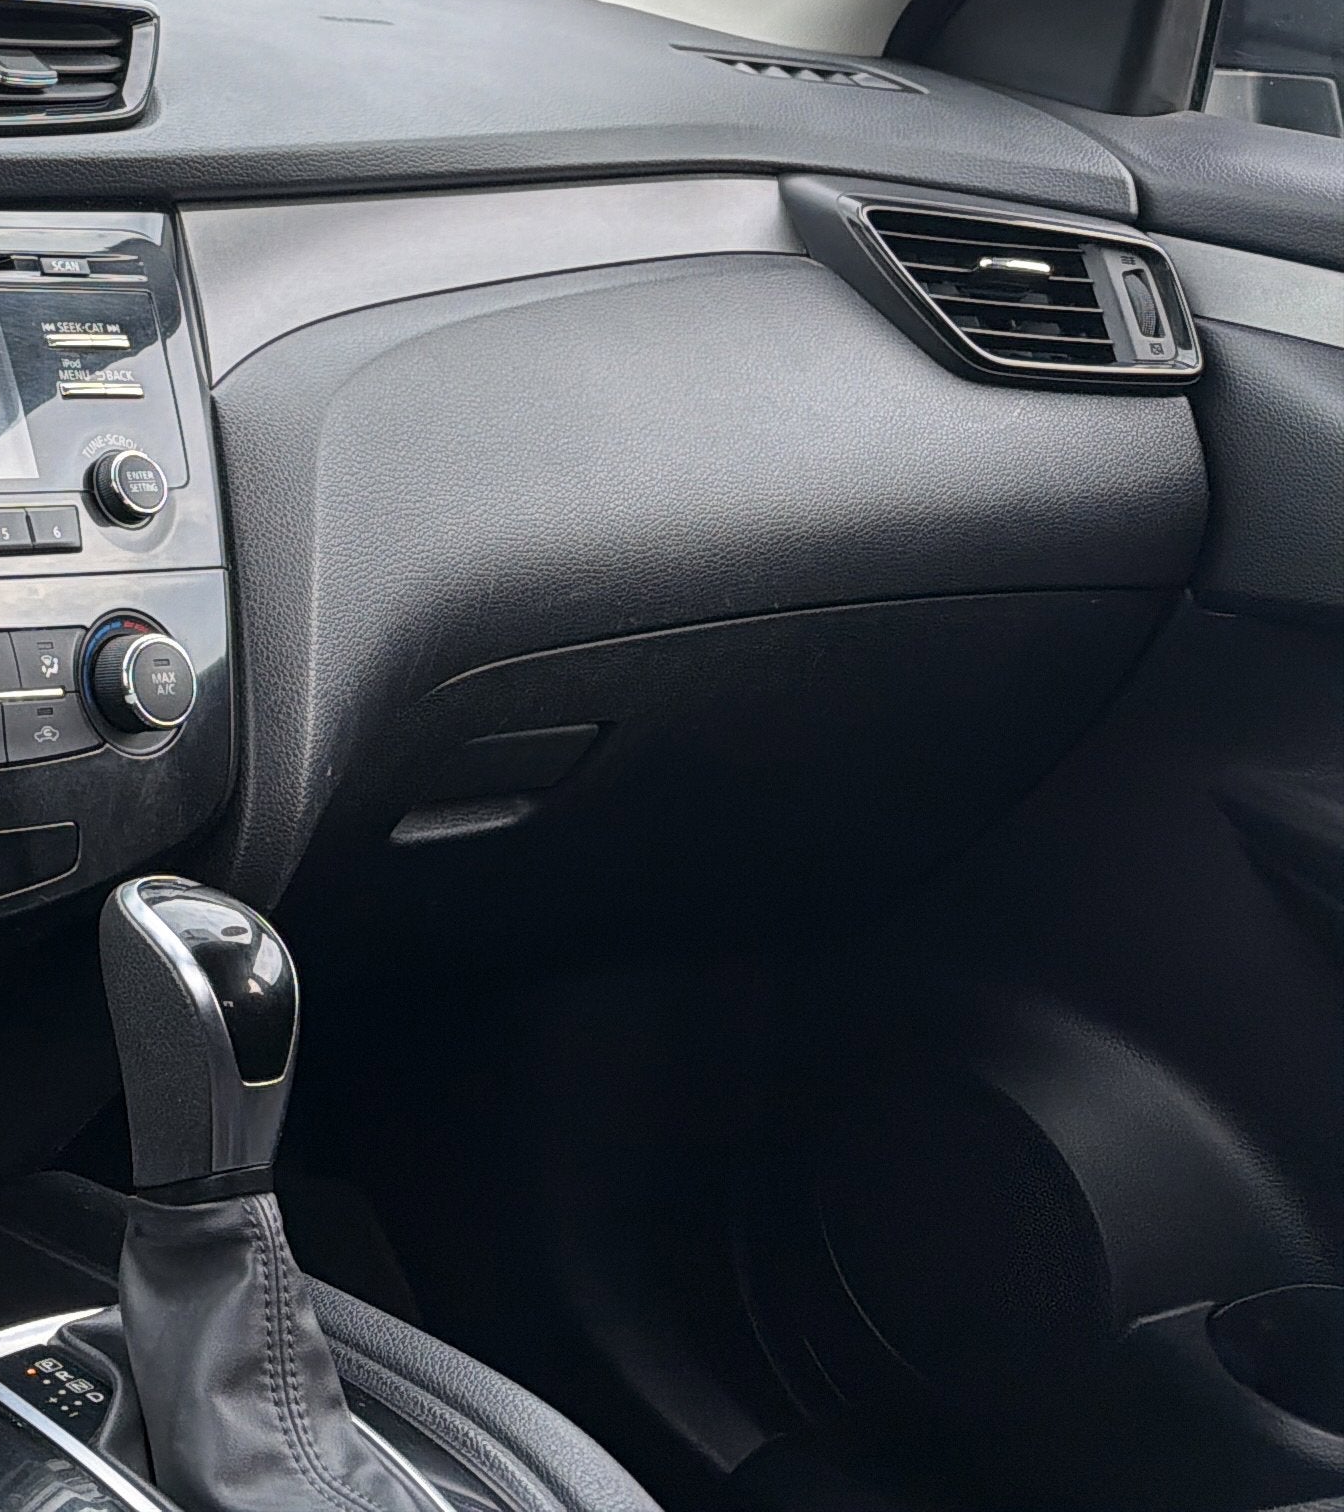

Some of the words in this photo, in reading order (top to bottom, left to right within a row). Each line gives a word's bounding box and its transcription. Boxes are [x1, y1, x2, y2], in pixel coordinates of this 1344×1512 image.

[50, 260, 80, 272] SCAN
[61, 358, 82, 369] iPod
[58, 369, 91, 382] MENU
[103, 370, 135, 382] BACK
[126, 470, 155, 481] ENTER
[0, 526, 9, 540] 5
[52, 525, 61, 538] 6
[151, 671, 177, 685] MAX
[156, 683, 177, 696] A/C
[55, 1371, 74, 1381] R
[86, 1392, 104, 1403] D
